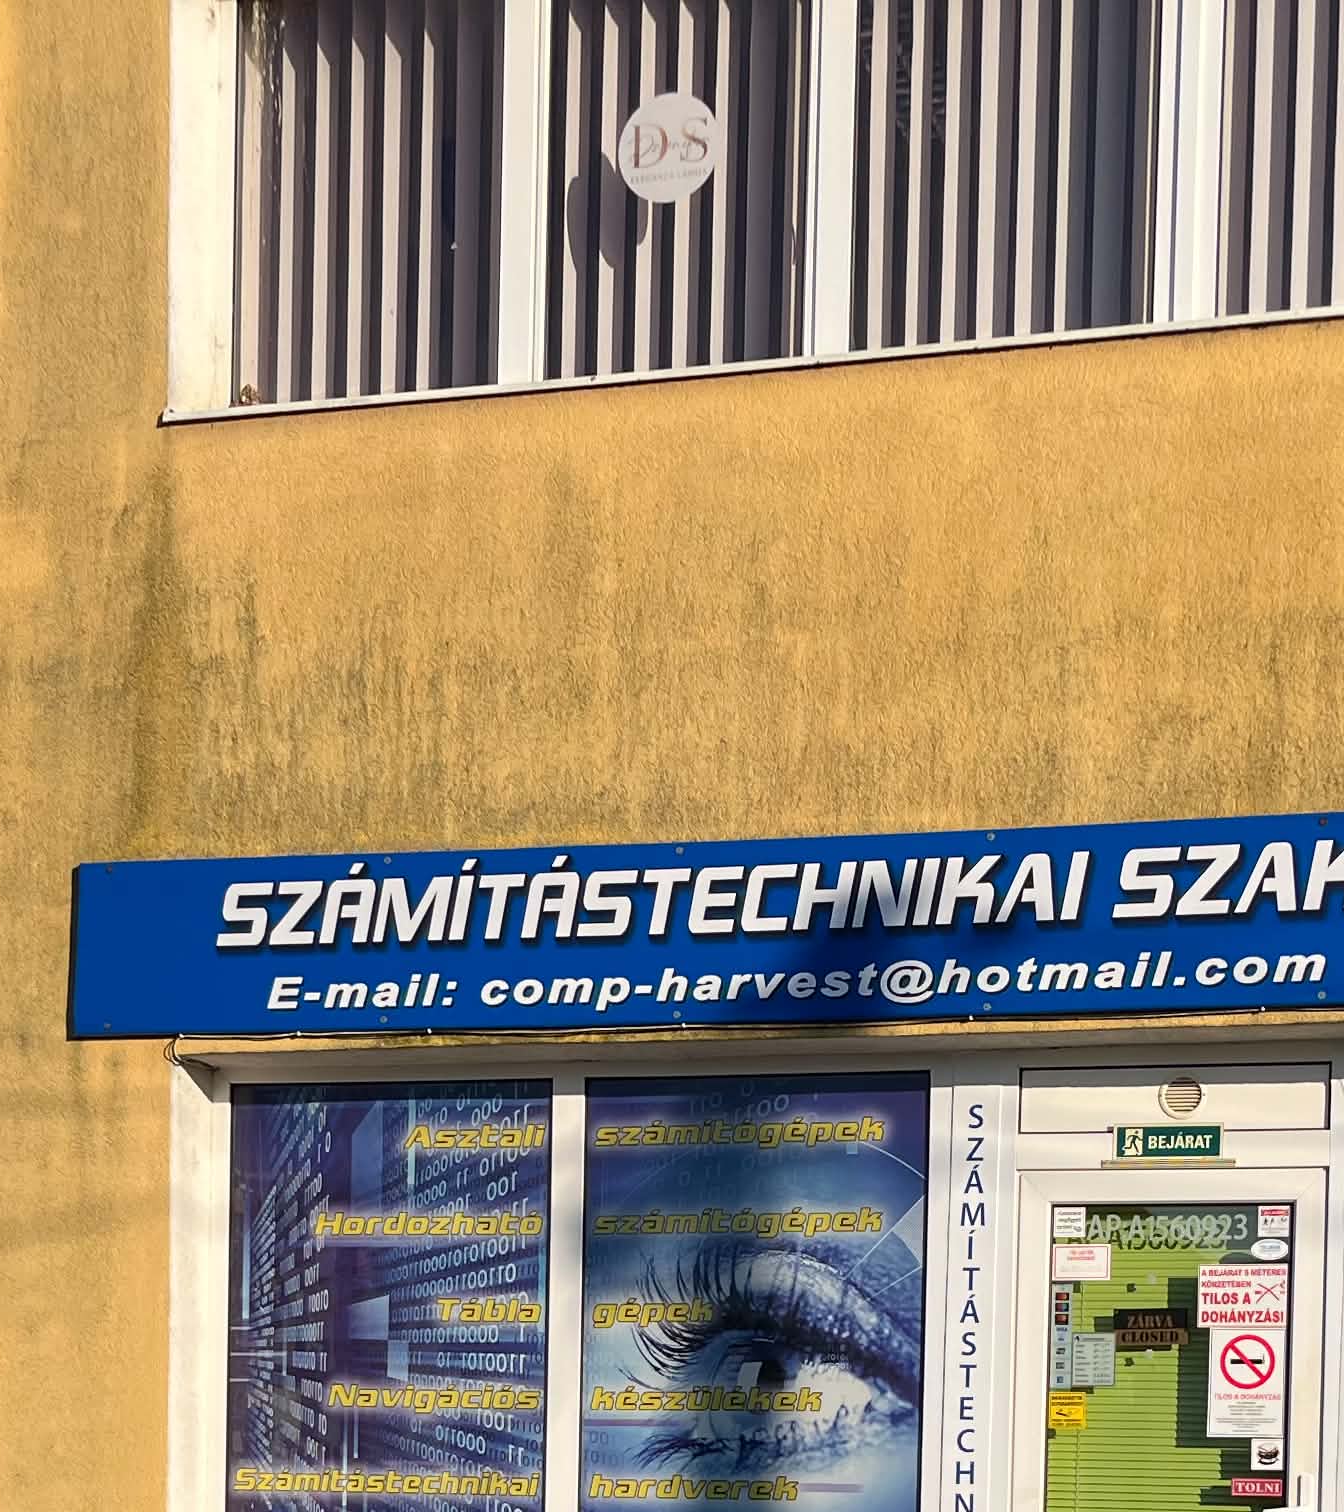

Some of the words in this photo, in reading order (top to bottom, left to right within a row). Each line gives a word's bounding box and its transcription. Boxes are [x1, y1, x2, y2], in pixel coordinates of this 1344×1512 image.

[216, 849, 1090, 948] SZÁMÍTÁSTECHNIKAI
[267, 974, 457, 1010] E-mail:
[481, 952, 1326, 1011] comp-harvest@hotmail.com
[404, 1123, 546, 1149] Asztali
[595, 1116, 885, 1147] számítógépek
[1148, 1131, 1213, 1151] BEJÁRAT
[315, 1209, 543, 1236] Hordozható
[593, 1207, 884, 1237] számítógépek
[437, 1297, 541, 1324] Tábla
[593, 1299, 713, 1328] gépek
[1201, 1292, 1238, 1304] TILOS
[1242, 1292, 1251, 1304] A
[1128, 1312, 1174, 1328] ZÁRVA
[1121, 1331, 1179, 1344] CLOSED
[328, 1384, 540, 1413] Navigációs
[591, 1387, 822, 1412] készülékek
[234, 1468, 538, 1496] Számítástechnikai
[590, 1475, 799, 1500] hardverek
[1236, 1482, 1280, 1493] TOLNI
